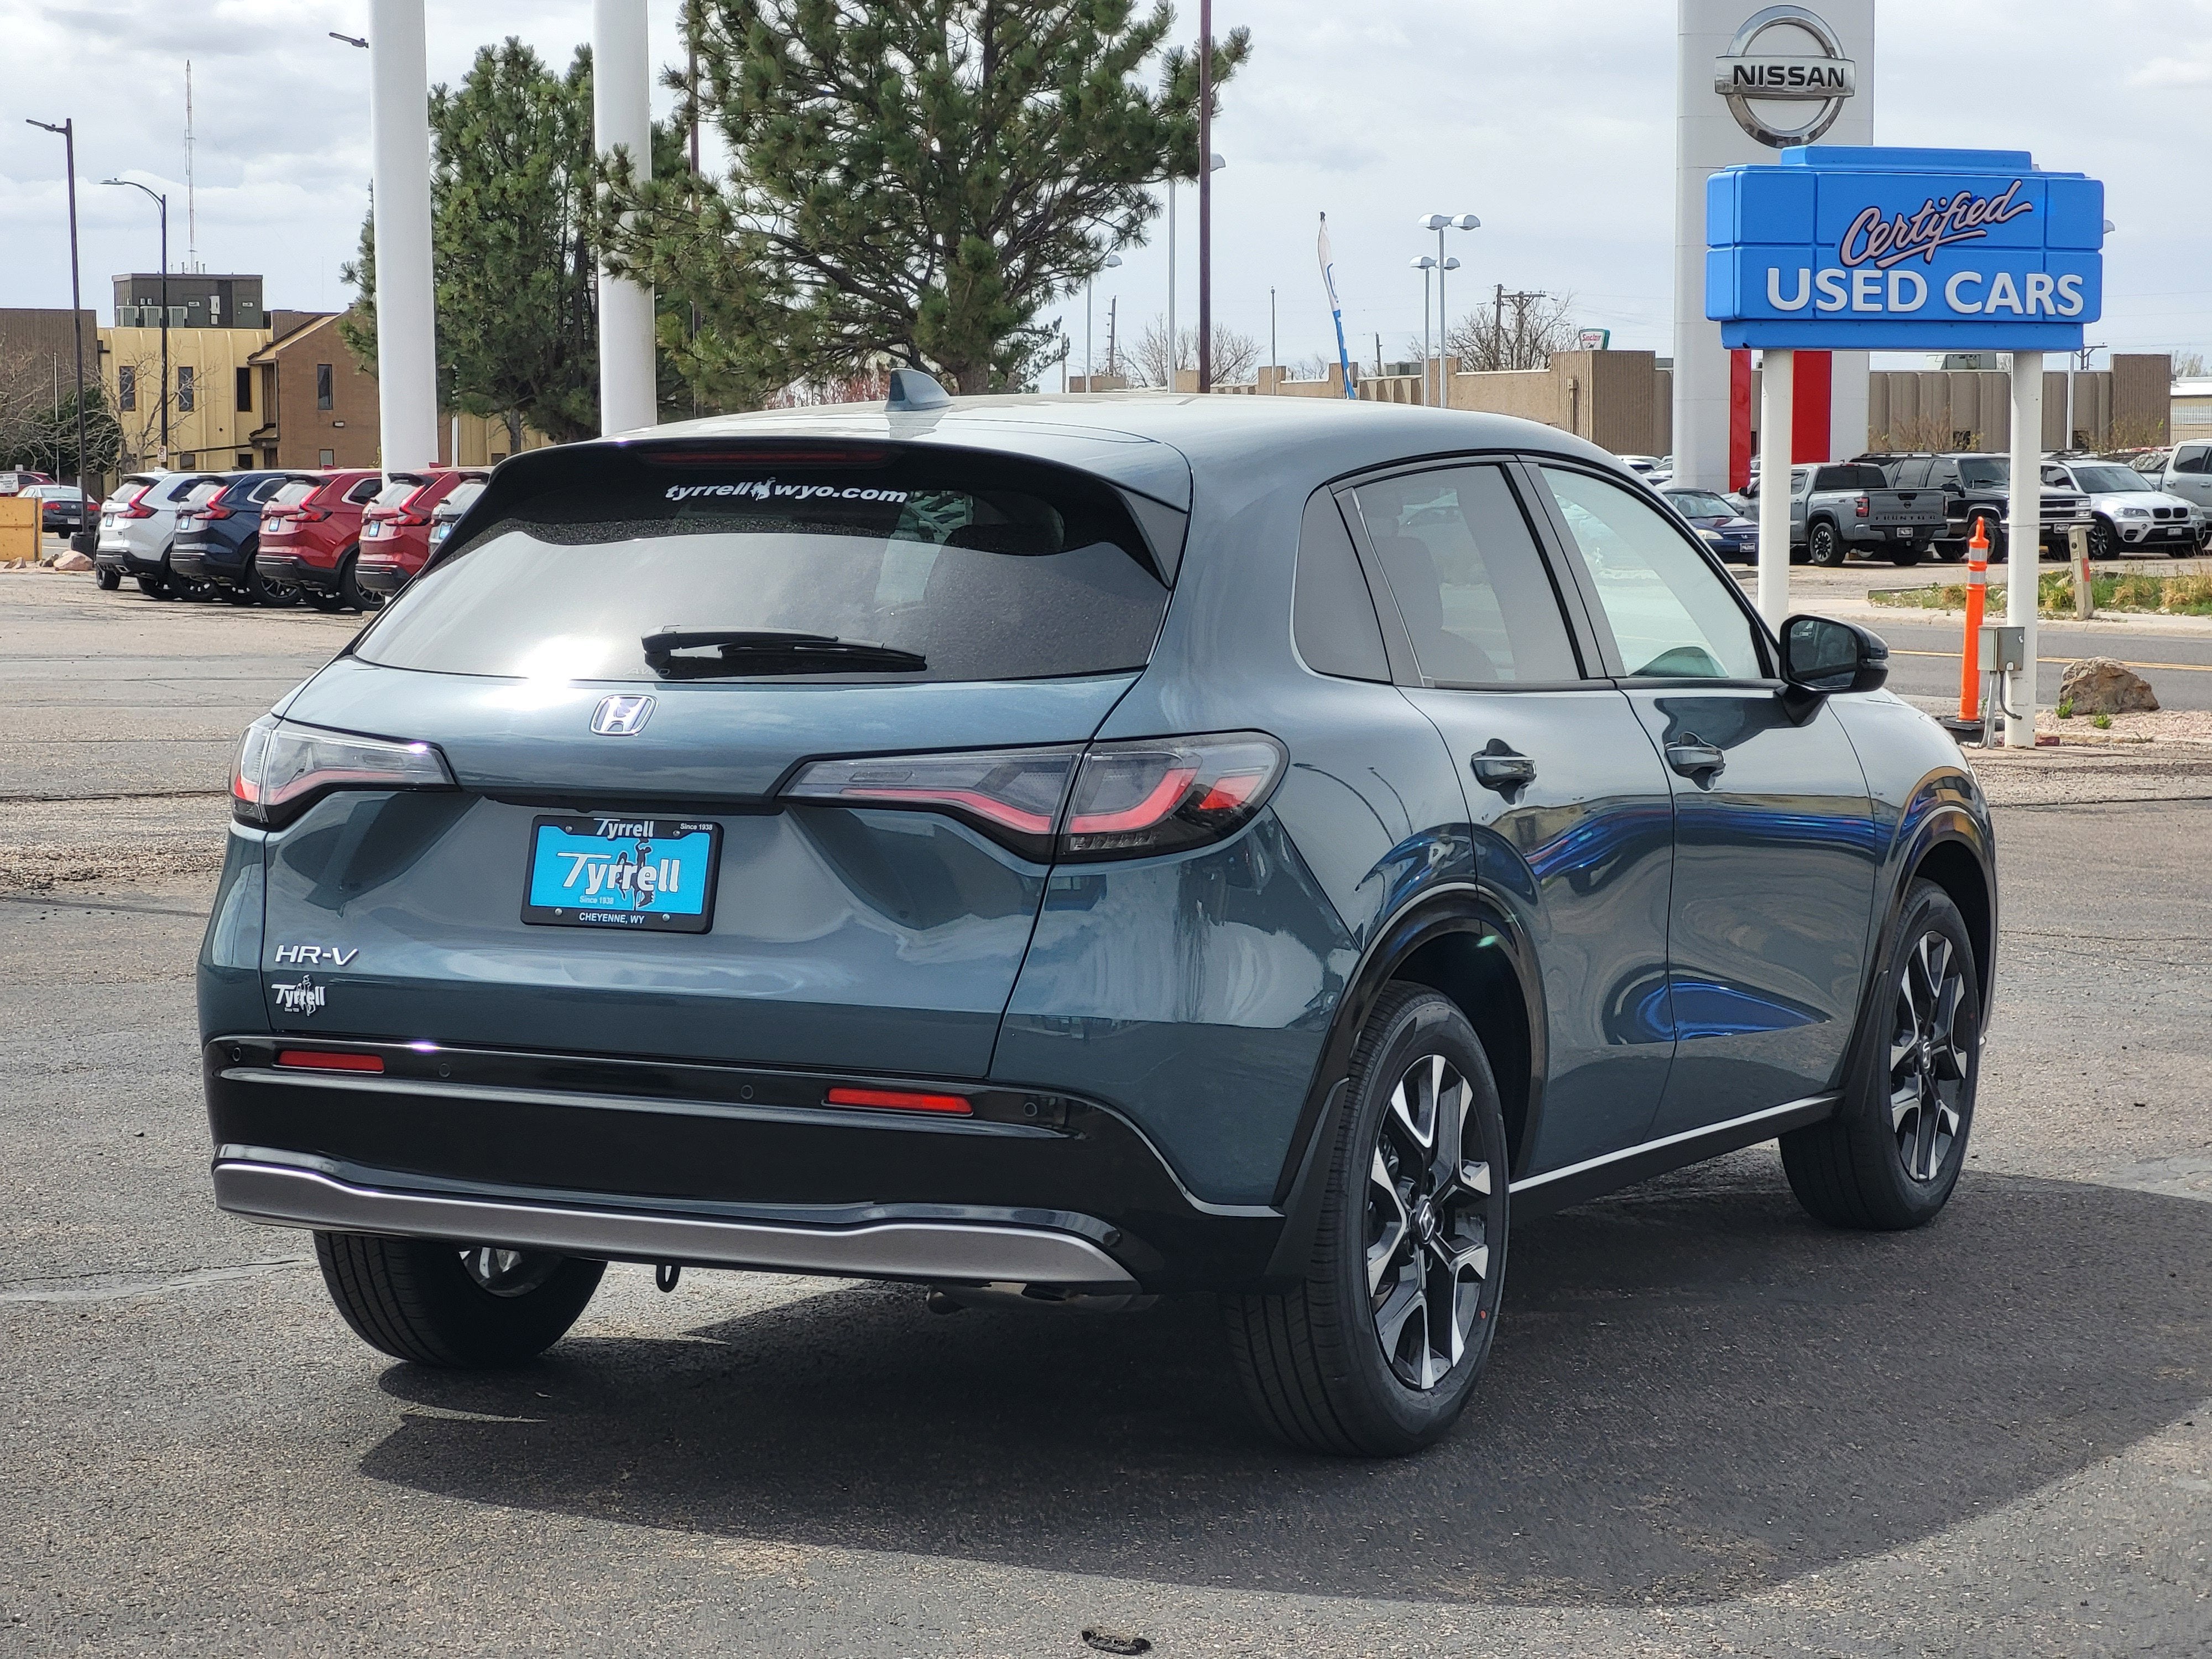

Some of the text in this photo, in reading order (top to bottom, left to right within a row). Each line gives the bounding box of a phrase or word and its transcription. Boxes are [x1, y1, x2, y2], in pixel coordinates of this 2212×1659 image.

[1733, 65, 1845, 88] NISSAN
[1839, 179, 2033, 268] Certified
[1767, 268, 2084, 317] USED CARS
[593, 818, 654, 839] Tyrrell
[556, 852, 681, 895] Tyrrell
[579, 912, 645, 924] CHEYENNE, WY
[275, 945, 359, 966] HR-V
[271, 983, 326, 1008] Tyrrell
